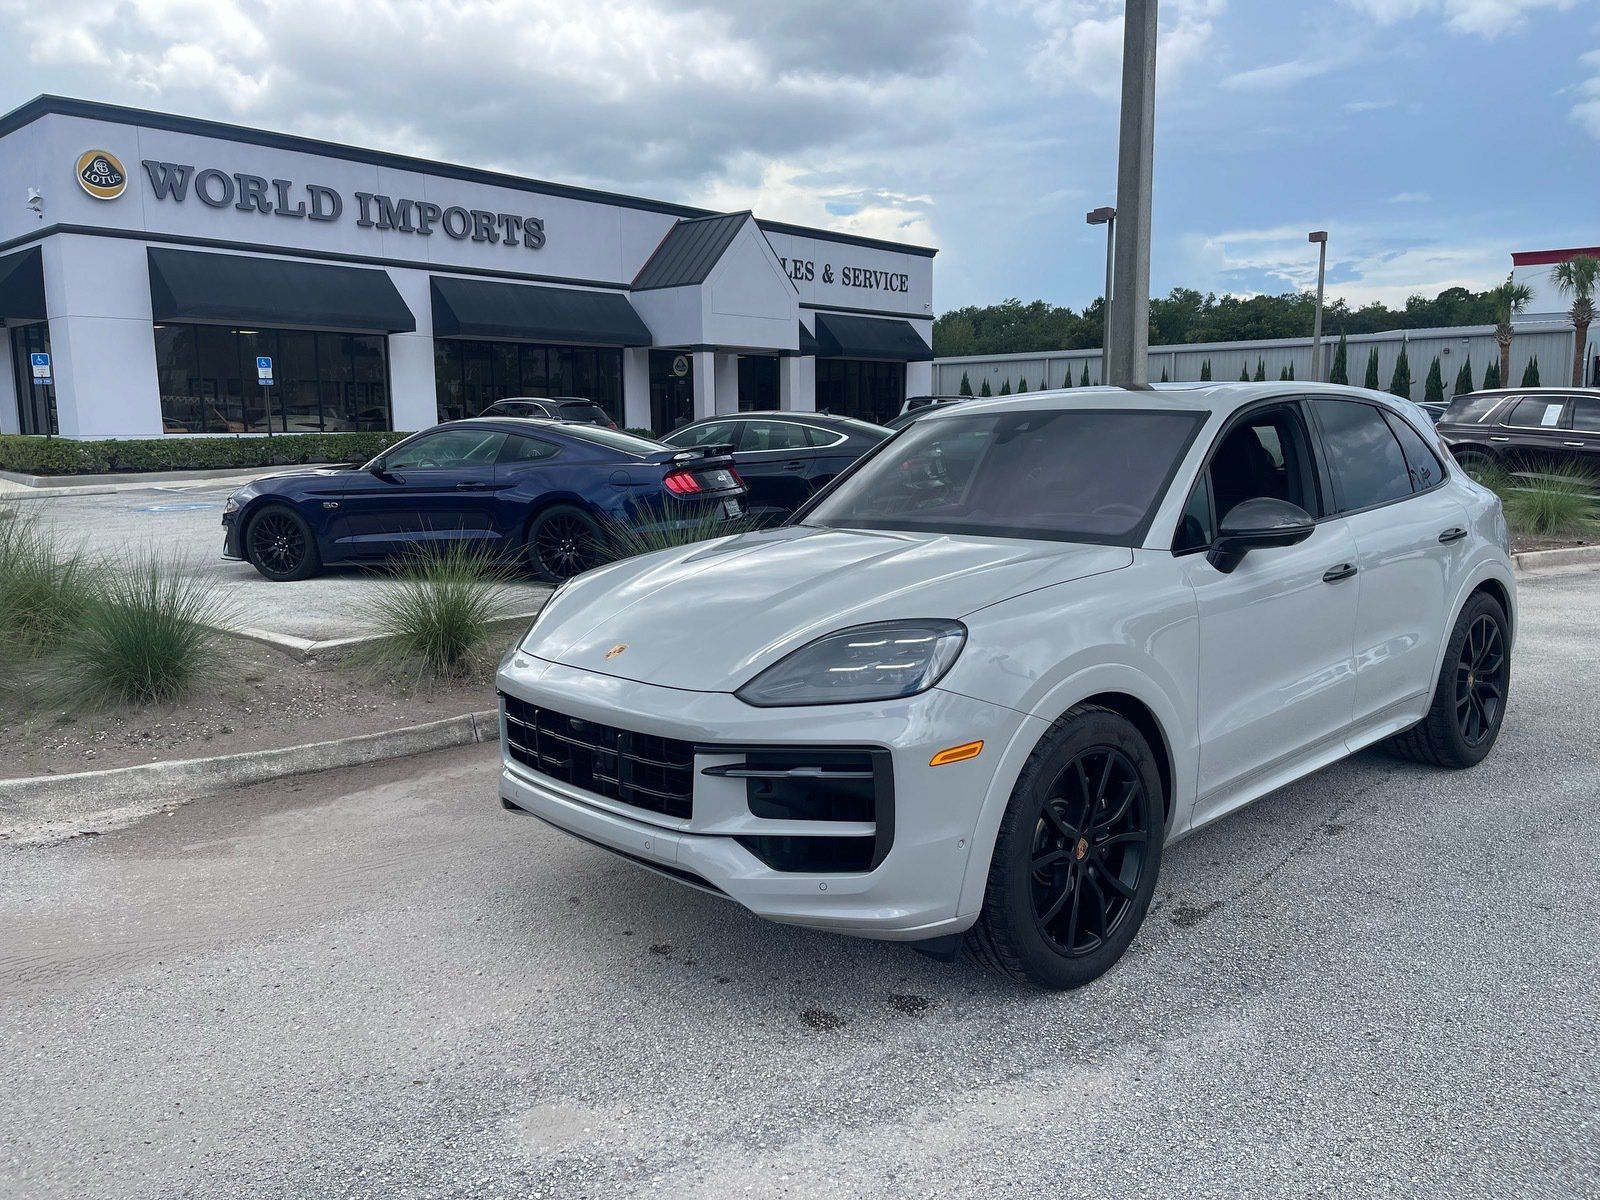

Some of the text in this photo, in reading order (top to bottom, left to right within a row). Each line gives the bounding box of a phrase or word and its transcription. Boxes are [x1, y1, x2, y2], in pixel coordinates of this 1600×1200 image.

[84, 171, 121, 184] LOTUS
[142, 160, 546, 249] WORLD IMPORTS
[781, 257, 909, 293] LES & SERVICE
